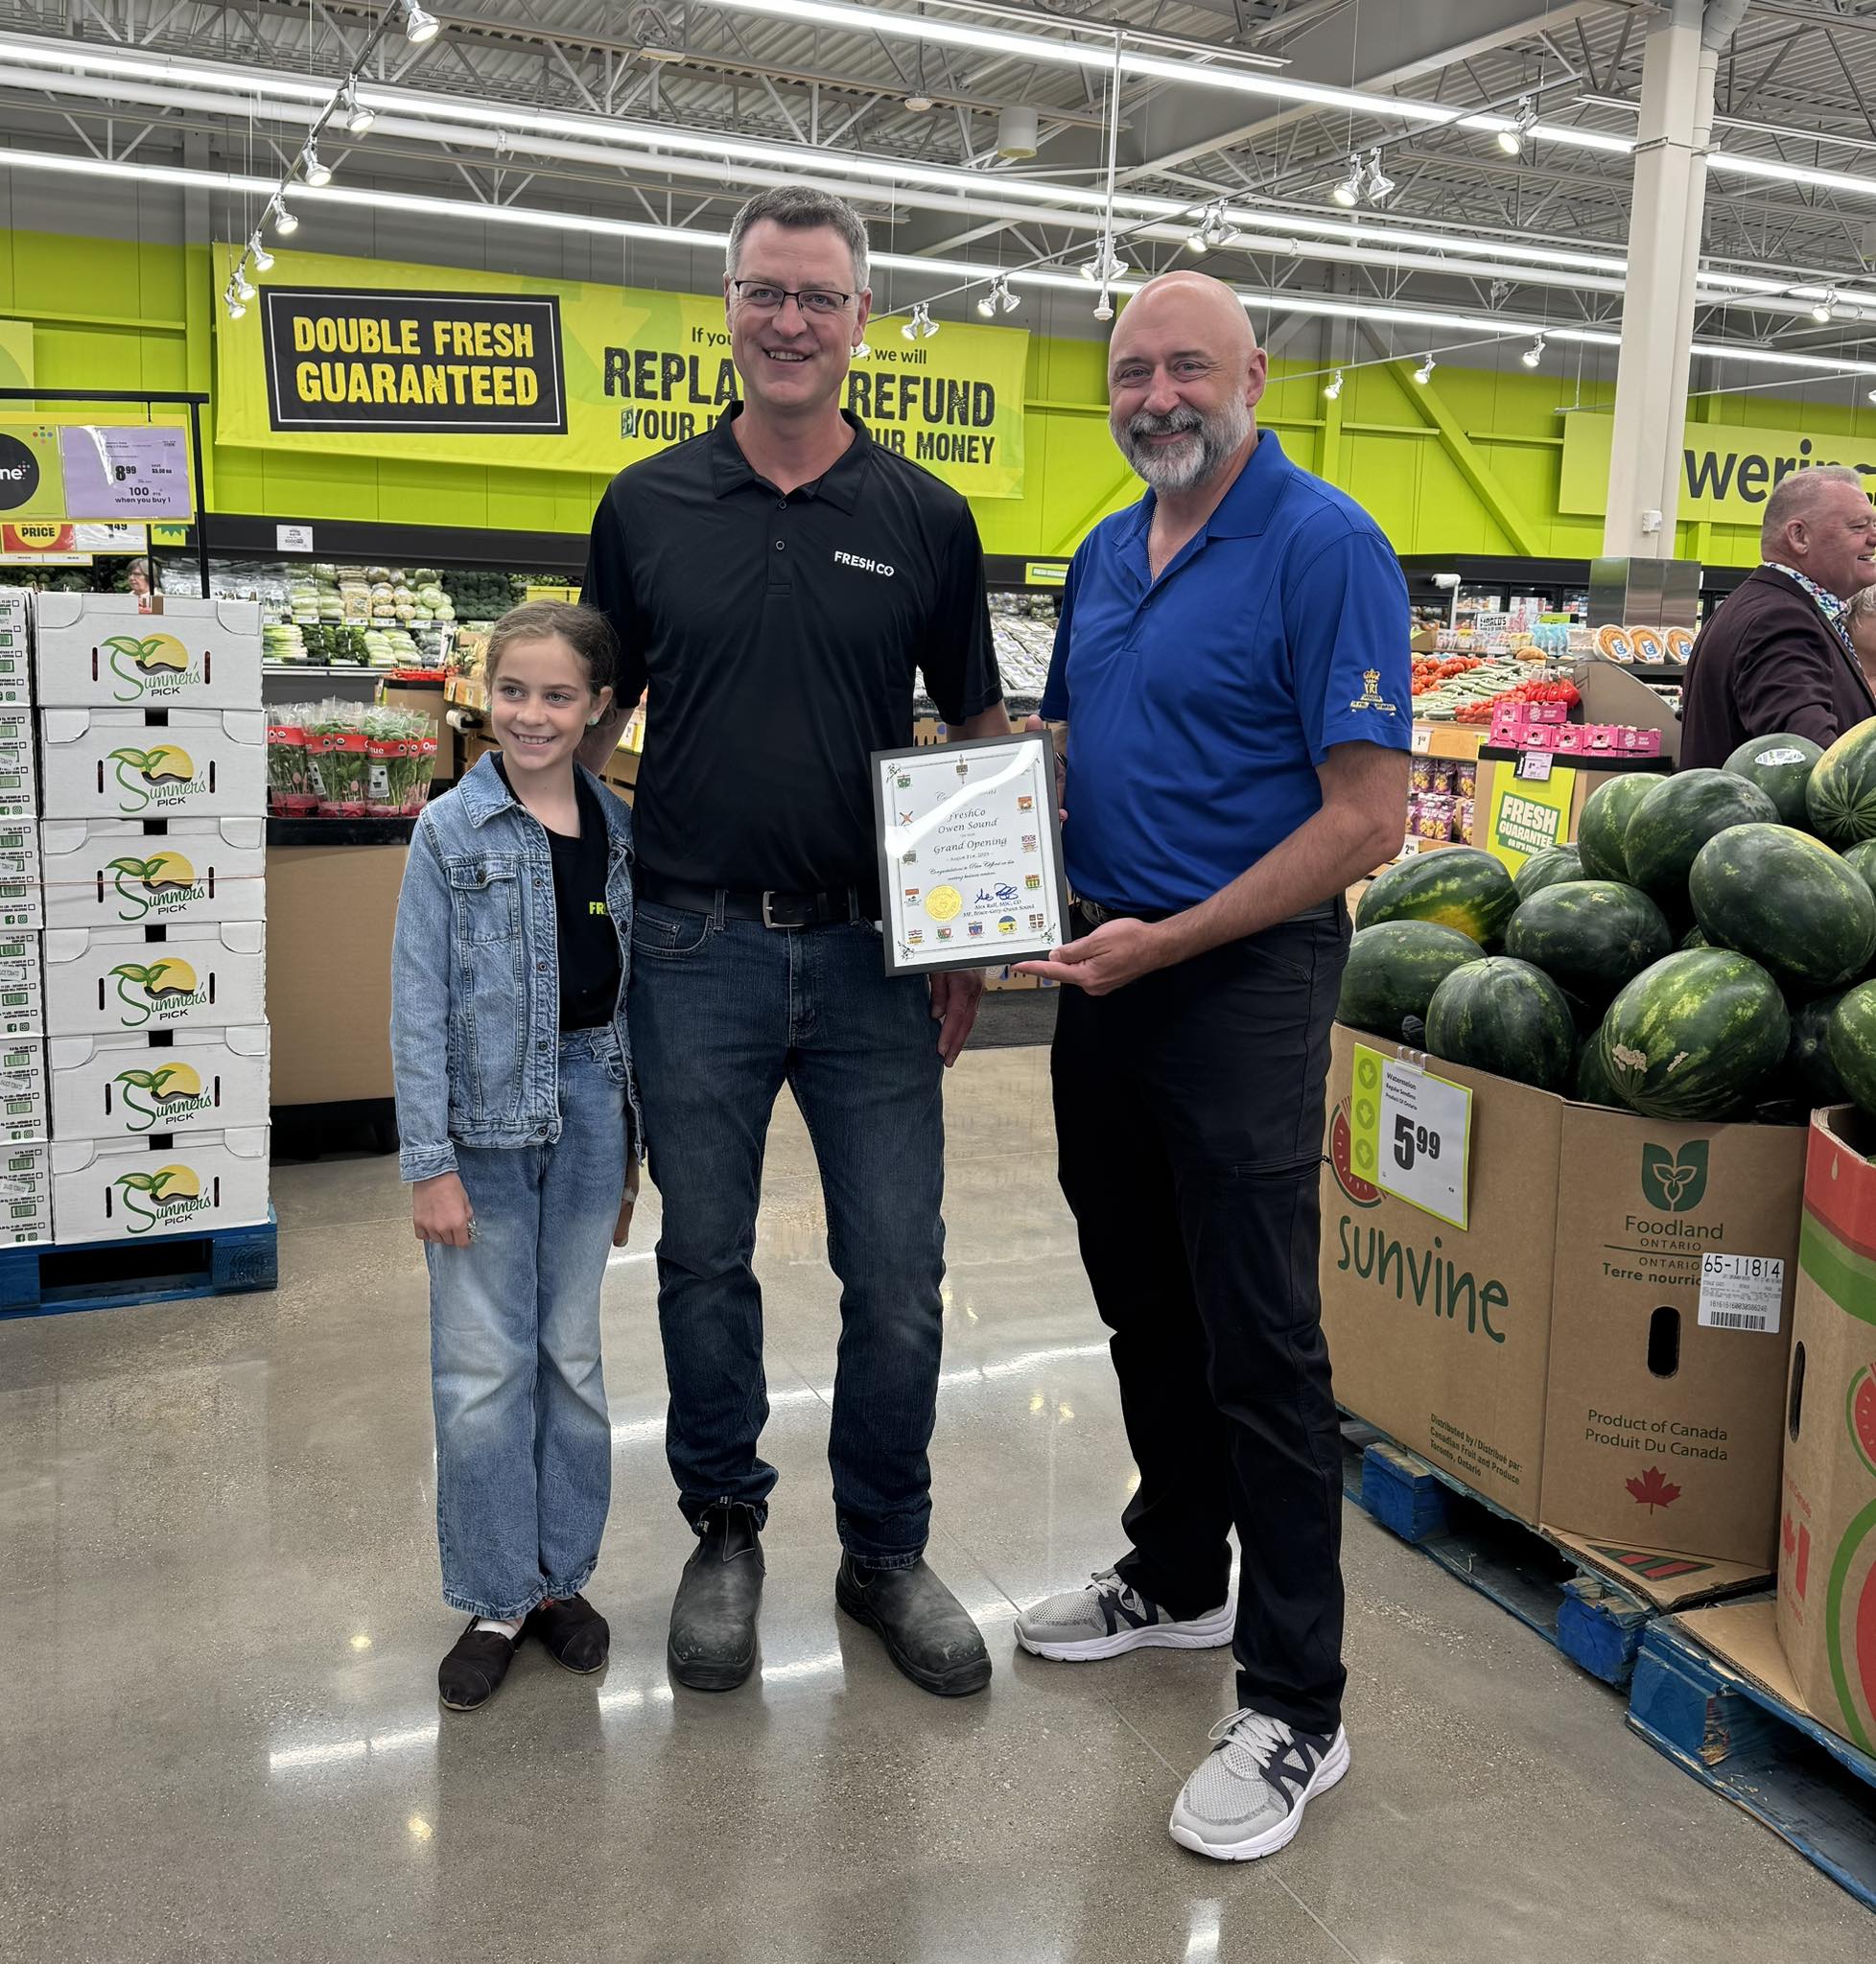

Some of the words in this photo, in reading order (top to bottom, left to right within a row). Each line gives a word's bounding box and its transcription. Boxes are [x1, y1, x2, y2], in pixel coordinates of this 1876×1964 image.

[293, 316, 421, 355] DOUBLE
[434, 320, 533, 358] FRESH
[692, 327, 701, 342] If
[875, 350, 897, 362] we
[901, 349, 927, 364] will
[295, 362, 538, 407] GUARANTEED
[604, 346, 739, 406] REPLA
[848, 370, 995, 428] REFUND
[632, 409, 695, 441] YOUR
[916, 432, 996, 464] MONEY
[129, 487, 149, 496] 100
[21, 527, 56, 537] PRICE
[152, 687, 180, 696] PICK
[157, 797, 186, 807] PICK
[938, 824, 965, 834] Owen
[968, 817, 998, 830] Sound
[1501, 795, 1559, 835] FRESH
[933, 840, 964, 853] Grand
[967, 837, 1007, 851] Opening
[1499, 821, 1554, 847] GUARANTEE
[157, 903, 187, 915] PICK
[159, 1009, 188, 1020] PICK
[166, 1112, 194, 1124] PICK
[165, 1214, 193, 1226] PICK
[1626, 1215, 1724, 1240] Foodland
[1640, 1237, 1701, 1251] ONTARIO
[1603, 1262, 1643, 1281] Terre
[1649, 1274, 1701, 1286] nourric
[1638, 1256, 1700, 1271] ONTARIO
[1703, 1254, 1781, 1278] 65-11814
[1337, 1214, 1509, 1343] sunvine
[1431, 1414, 1465, 1439] Distributed
[1588, 1409, 1648, 1431] Product
[1651, 1420, 1667, 1433] of
[1670, 1422, 1727, 1440] Canada
[1430, 1427, 1460, 1451] Canadian
[1462, 1444, 1477, 1461] Fruit
[1477, 1457, 1490, 1468] and
[1492, 1461, 1520, 1485] Produce
[1585, 1428, 1641, 1450] Produit
[1644, 1438, 1666, 1454] Du
[1670, 1442, 1727, 1461] Canada
[1430, 1438, 1456, 1463] Toronto,
[1458, 1456, 1482, 1477] Ontario
